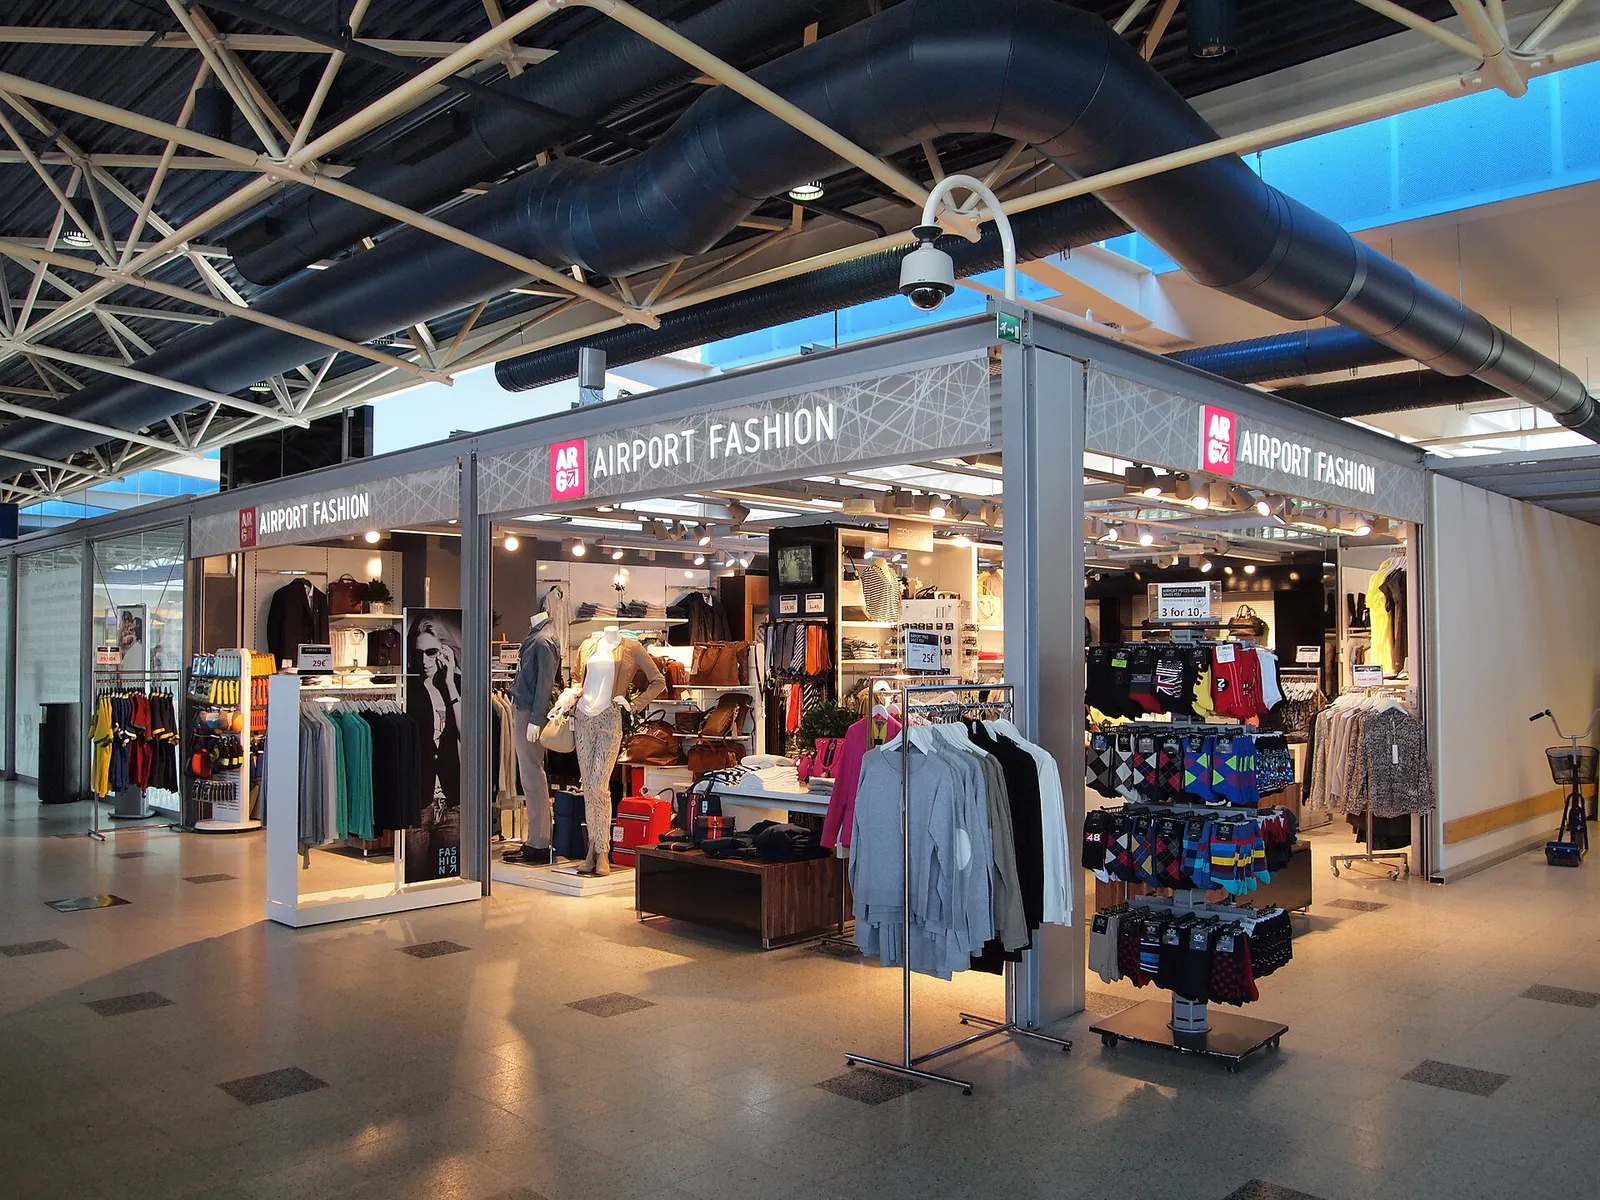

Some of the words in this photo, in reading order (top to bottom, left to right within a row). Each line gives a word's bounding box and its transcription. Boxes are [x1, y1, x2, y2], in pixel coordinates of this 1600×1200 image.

[1208, 413, 1231, 443] AR
[593, 428, 696, 479] AIRPORT
[709, 403, 834, 460] FASHION
[555, 446, 578, 471] AR
[1240, 429, 1311, 479] AIRPORT
[1317, 451, 1375, 495] FASHION
[241, 511, 253, 528] AR
[259, 503, 308, 535] AIRPORT
[313, 492, 369, 526] FASHION
[1162, 608, 1168, 616] 3
[1170, 608, 1184, 616] for
[1188, 608, 1206, 618] 10,-
[922, 653, 934, 664] 25€
[1086, 833, 1101, 842] 48
[439, 847, 456, 856] FAS
[439, 856, 456, 865] HIO
[439, 866, 446, 874] N
